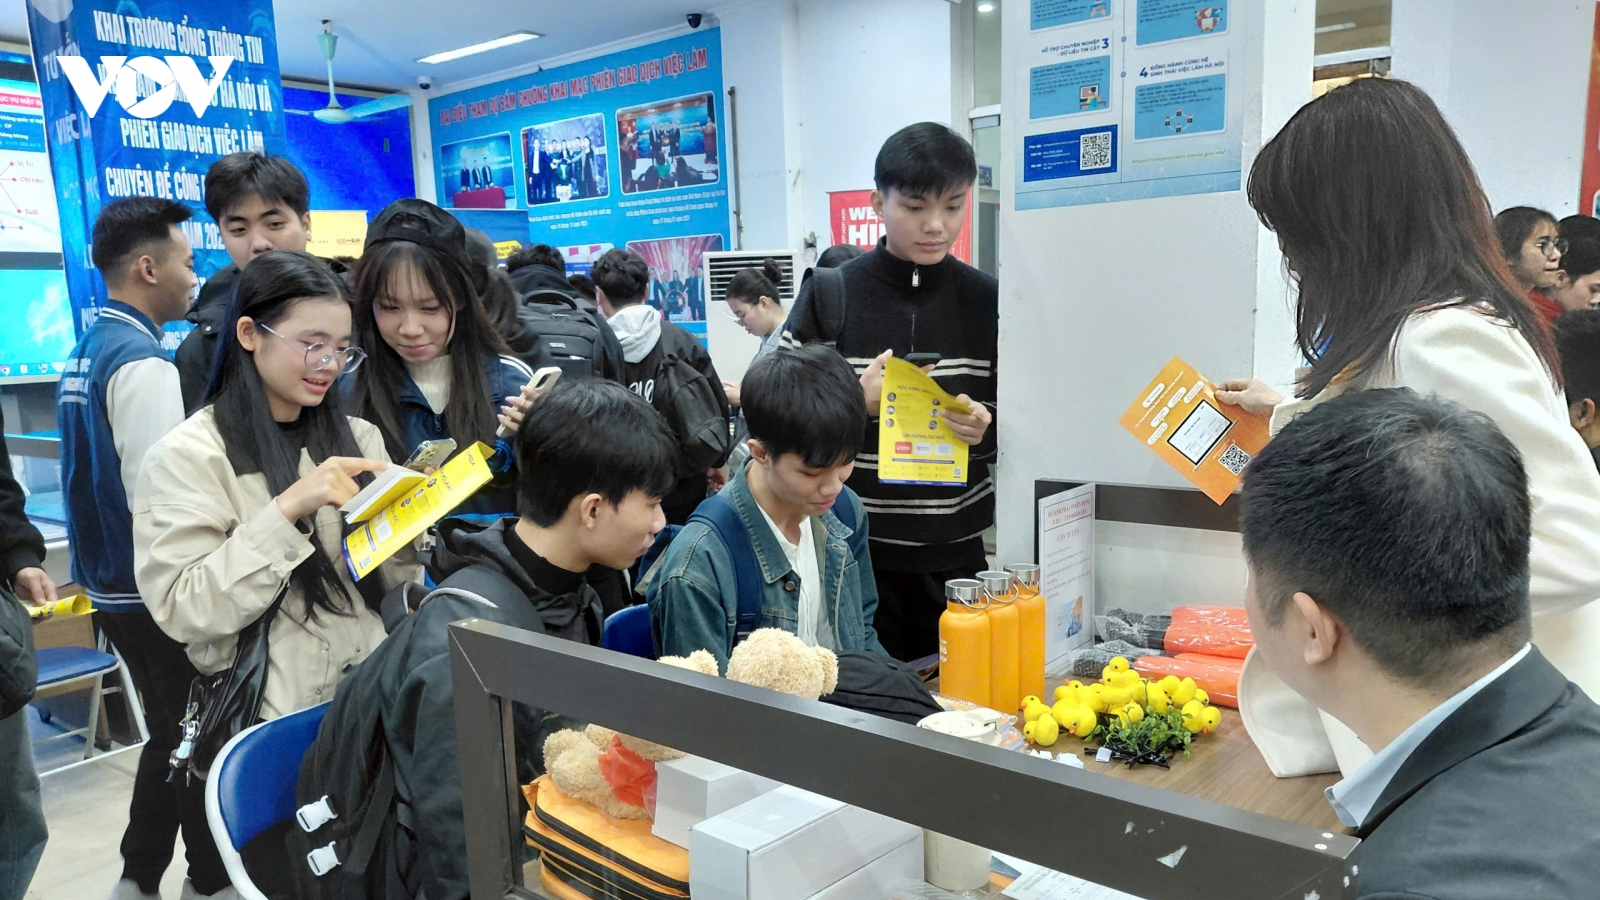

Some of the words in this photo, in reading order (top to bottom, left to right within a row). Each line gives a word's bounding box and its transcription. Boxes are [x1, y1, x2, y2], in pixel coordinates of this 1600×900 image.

[93, 10, 127, 44] KHAI
[126, 15, 177, 52] TRƯƠNG
[176, 15, 207, 57] CỔNG
[206, 26, 244, 62] THÔNG
[244, 35, 265, 64] TIN
[1060, 42, 1081, 50] CHUYÊN
[1101, 37, 1109, 49] 3
[468, 100, 488, 118] THAM
[517, 84, 549, 108] CHUÔNG
[549, 80, 569, 101] KHAI
[569, 75, 589, 98] MẠC
[590, 67, 616, 93] PHIÊN
[617, 64, 639, 87] GIAO
[639, 58, 662, 84] DỊCH
[662, 51, 684, 79] VIỆC
[686, 46, 708, 72] LÀM
[1139, 67, 1148, 78] 4
[1178, 65, 1190, 73] VIỆC
[1214, 60, 1225, 68] NỘI
[236, 76, 258, 117] NỘI
[256, 79, 277, 113] VÀ
[160, 121, 188, 151] GIAO
[186, 124, 213, 159] DỊCH
[240, 125, 265, 157] LÀM
[105, 163, 155, 198] CHUYÊN
[173, 166, 201, 202] CÔNG
